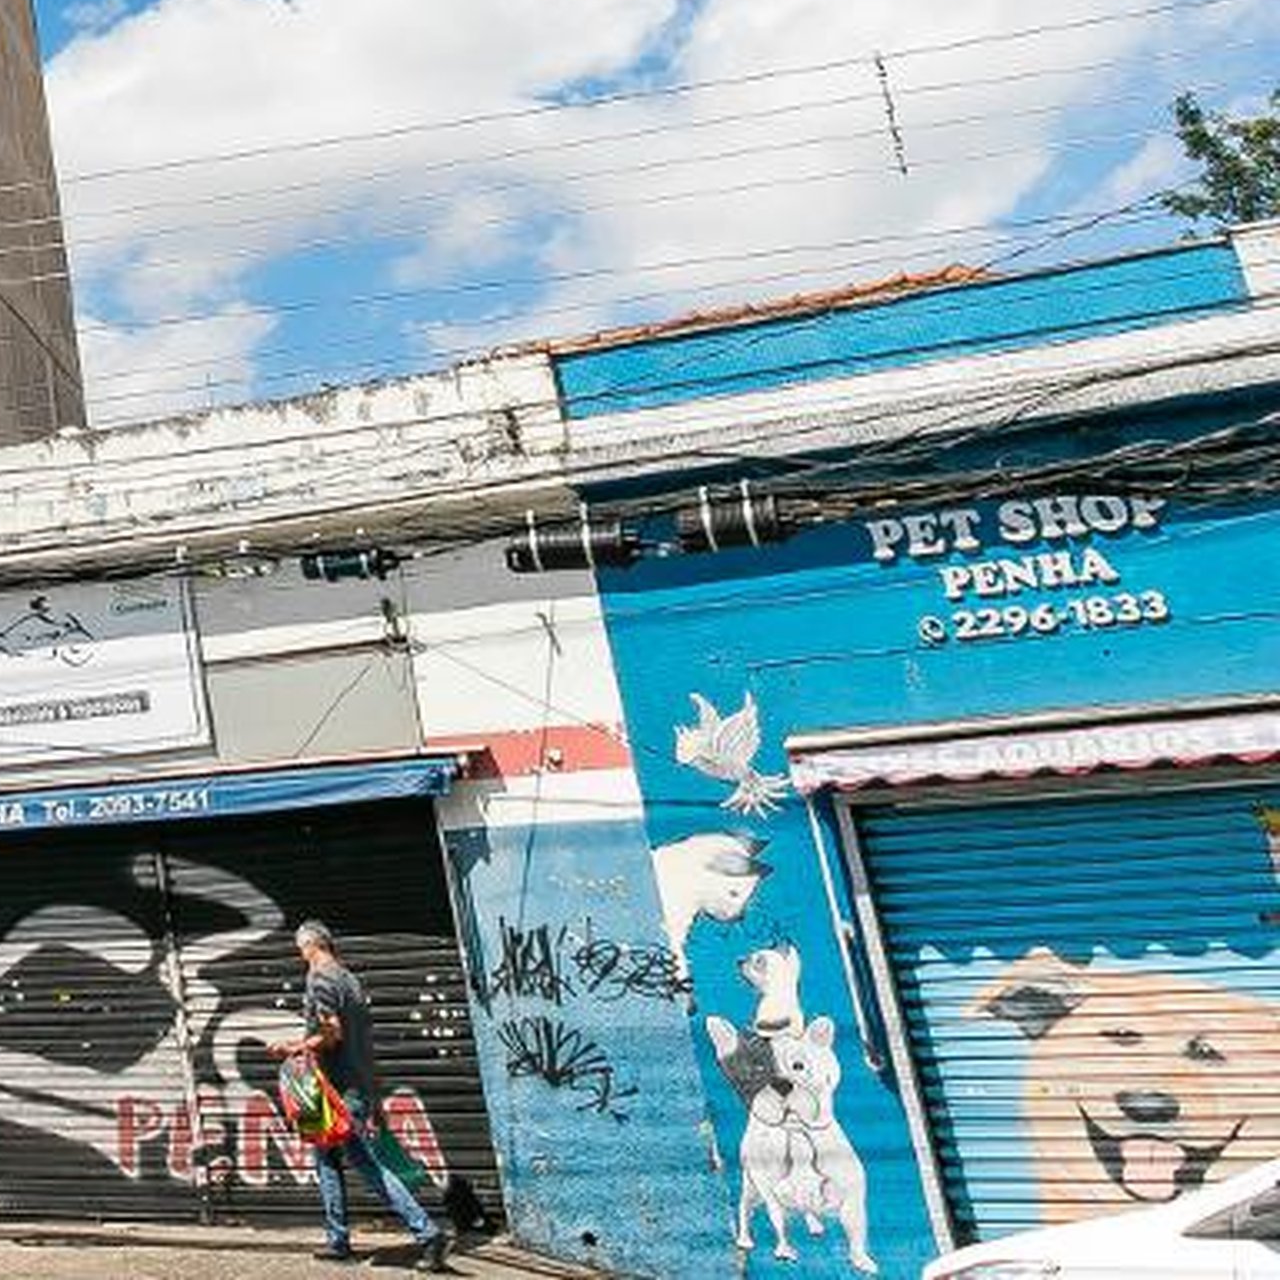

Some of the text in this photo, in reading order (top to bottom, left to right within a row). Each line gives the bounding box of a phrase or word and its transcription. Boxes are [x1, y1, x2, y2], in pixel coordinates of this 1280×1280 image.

[866, 509, 981, 561] PET
[941, 549, 1120, 600] PENHA
[952, 590, 1169, 640] 2296-1833
[43, 800, 82, 821] Tel.
[90, 788, 210, 818] 2093-7541
[116, 1085, 447, 1192] PENA
